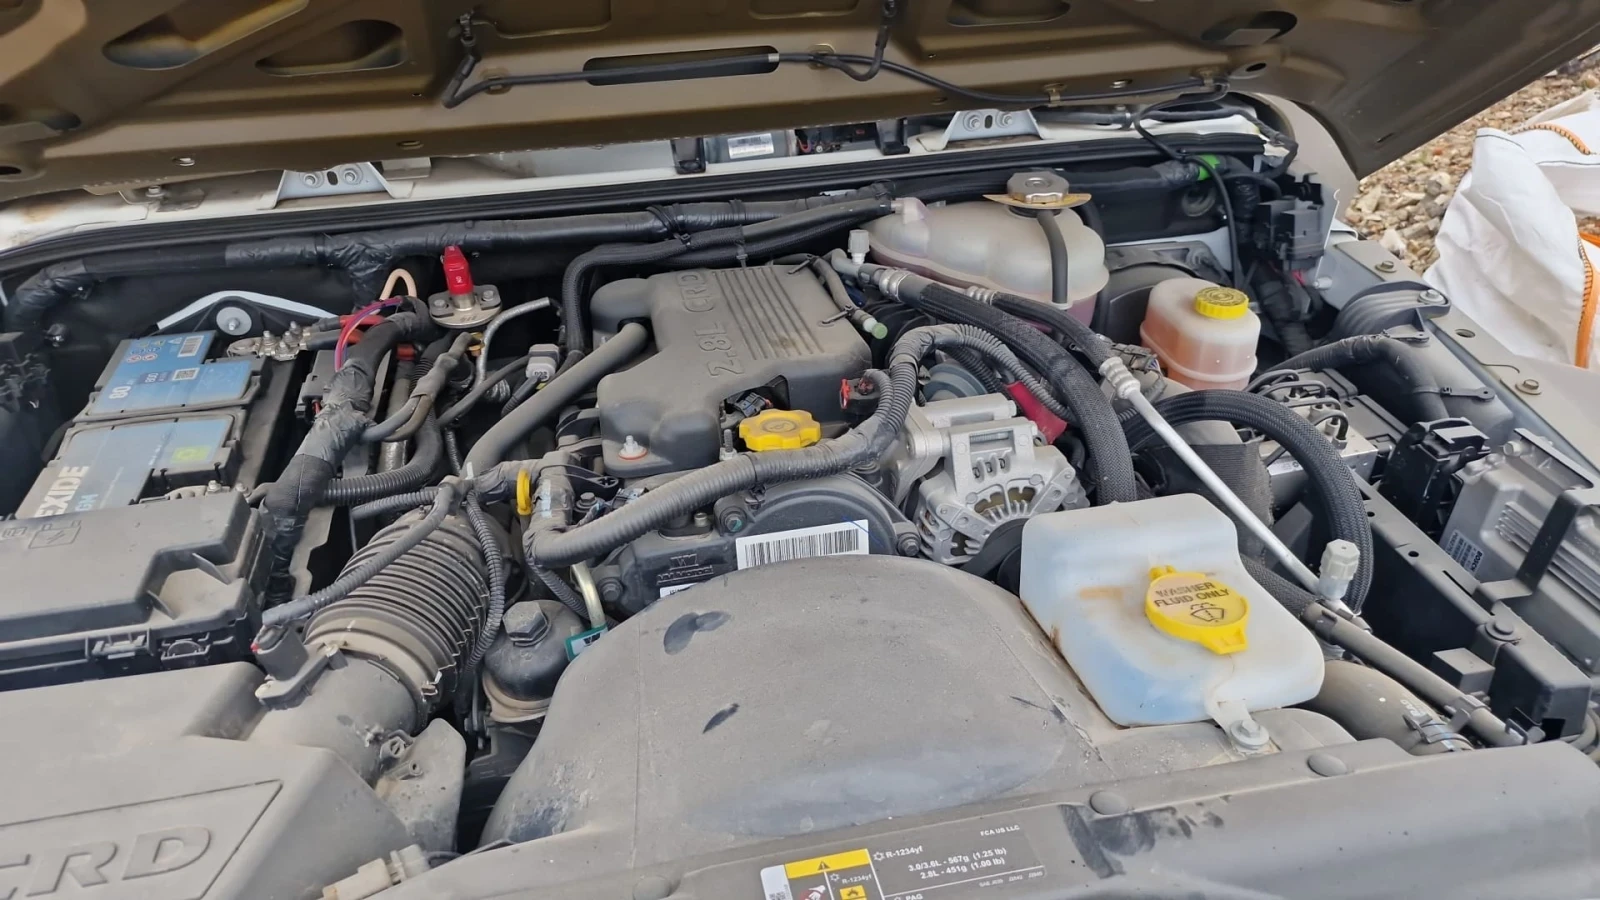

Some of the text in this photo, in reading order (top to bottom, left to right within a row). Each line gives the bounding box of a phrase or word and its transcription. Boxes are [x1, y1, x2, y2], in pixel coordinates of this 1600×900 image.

[676, 271, 745, 376] 2.8L CRD
[109, 386, 131, 399] 80
[34, 465, 90, 518] EXIDE
[1470, 550, 1483, 572] BOSCH
[1154, 588, 1230, 608] FLUID ONLY
[1155, 581, 1216, 597] WASHER
[980, 828, 995, 836] FCA
[0, 826, 212, 900] RD
[885, 846, 923, 858] R-1234yf
[908, 859, 942, 872] 3.0/3.6L
[947, 855, 970, 864] 567g
[972, 848, 994, 860] (1.25
[994, 847, 1007, 856] lb)
[920, 869, 940, 879] 2.8L
[946, 865, 968, 875] 451g
[970, 858, 992, 870] (1.00
[993, 857, 1006, 866] lb)
